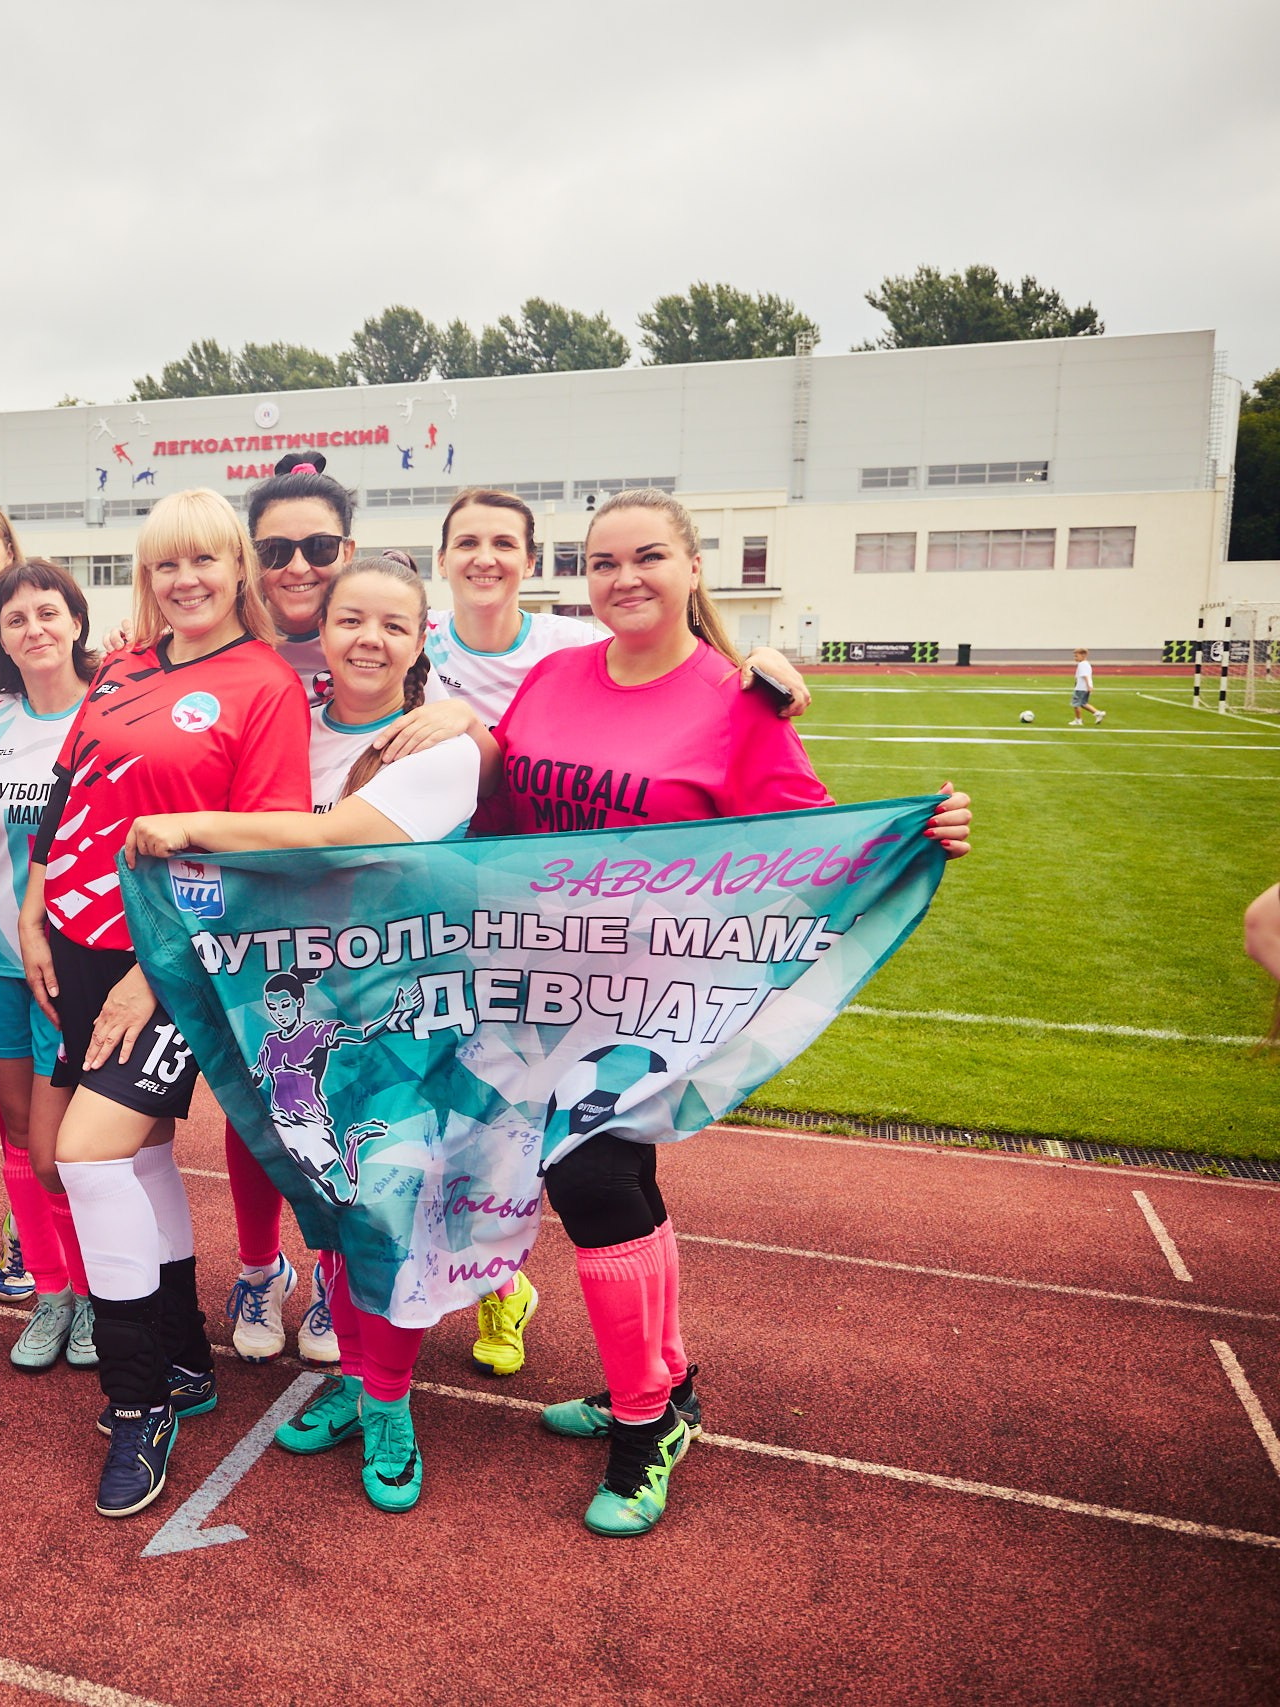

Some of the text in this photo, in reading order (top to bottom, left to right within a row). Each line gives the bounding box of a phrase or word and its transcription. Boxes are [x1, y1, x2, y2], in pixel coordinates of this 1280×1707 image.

[153, 424, 390, 456] ЛЕГКОАТЛЕТИЧЕСКИЙ
[227, 462, 275, 480] МАН
[7, 804, 47, 825] МАМ
[506, 755, 651, 818] FOOTBALL
[530, 834, 902, 898] ЗАВОЛЖЬЕ
[190, 910, 629, 975] ФУТБОЛЬНЫЕ
[386, 968, 790, 1044] «ДЕВЧАТ
[141, 1023, 193, 1084] 13
